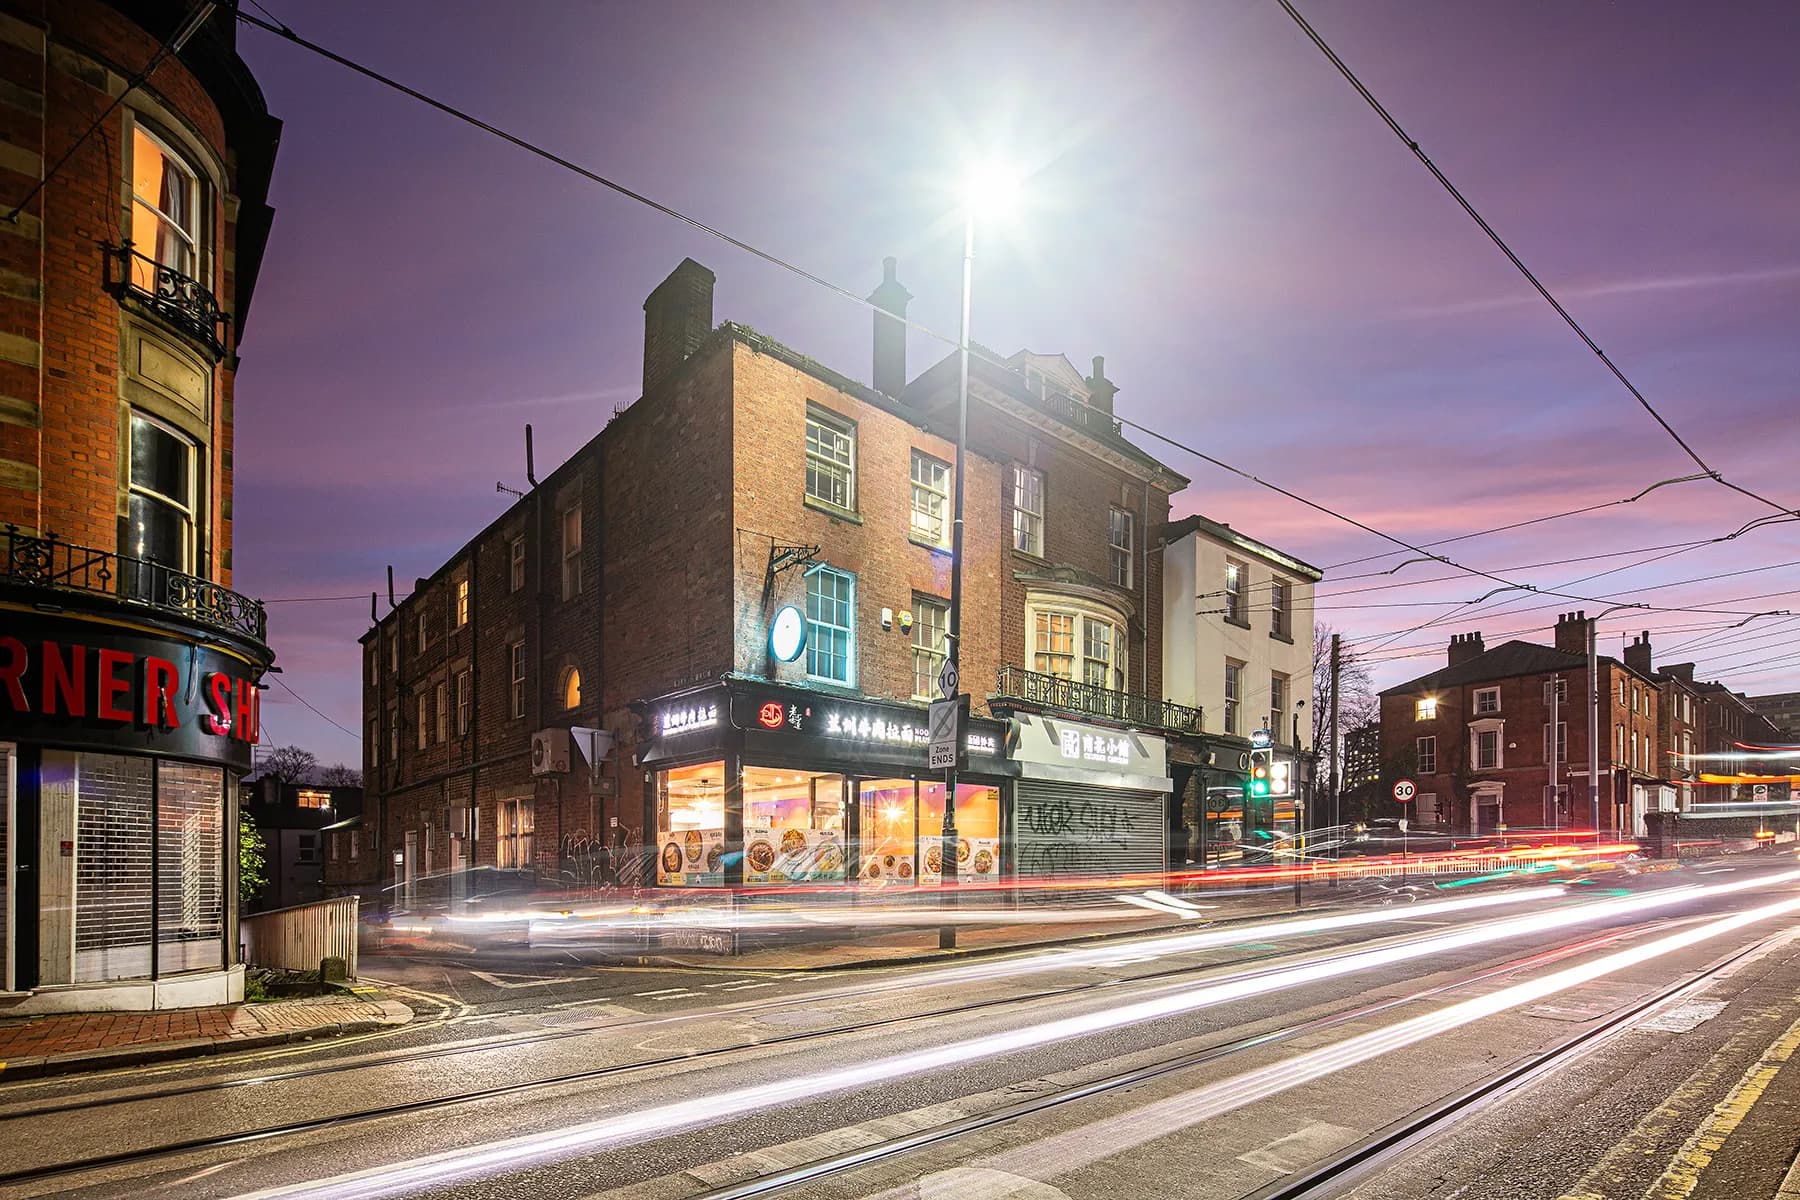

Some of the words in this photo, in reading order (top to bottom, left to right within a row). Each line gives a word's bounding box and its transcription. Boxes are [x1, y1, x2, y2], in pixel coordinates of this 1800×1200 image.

[941, 672, 957, 689] 10
[826, 713, 914, 743] 兰州牛肉拉面
[935, 746, 949, 754] Zone
[932, 754, 954, 765] ENDS
[1396, 785, 1413, 796] 30
